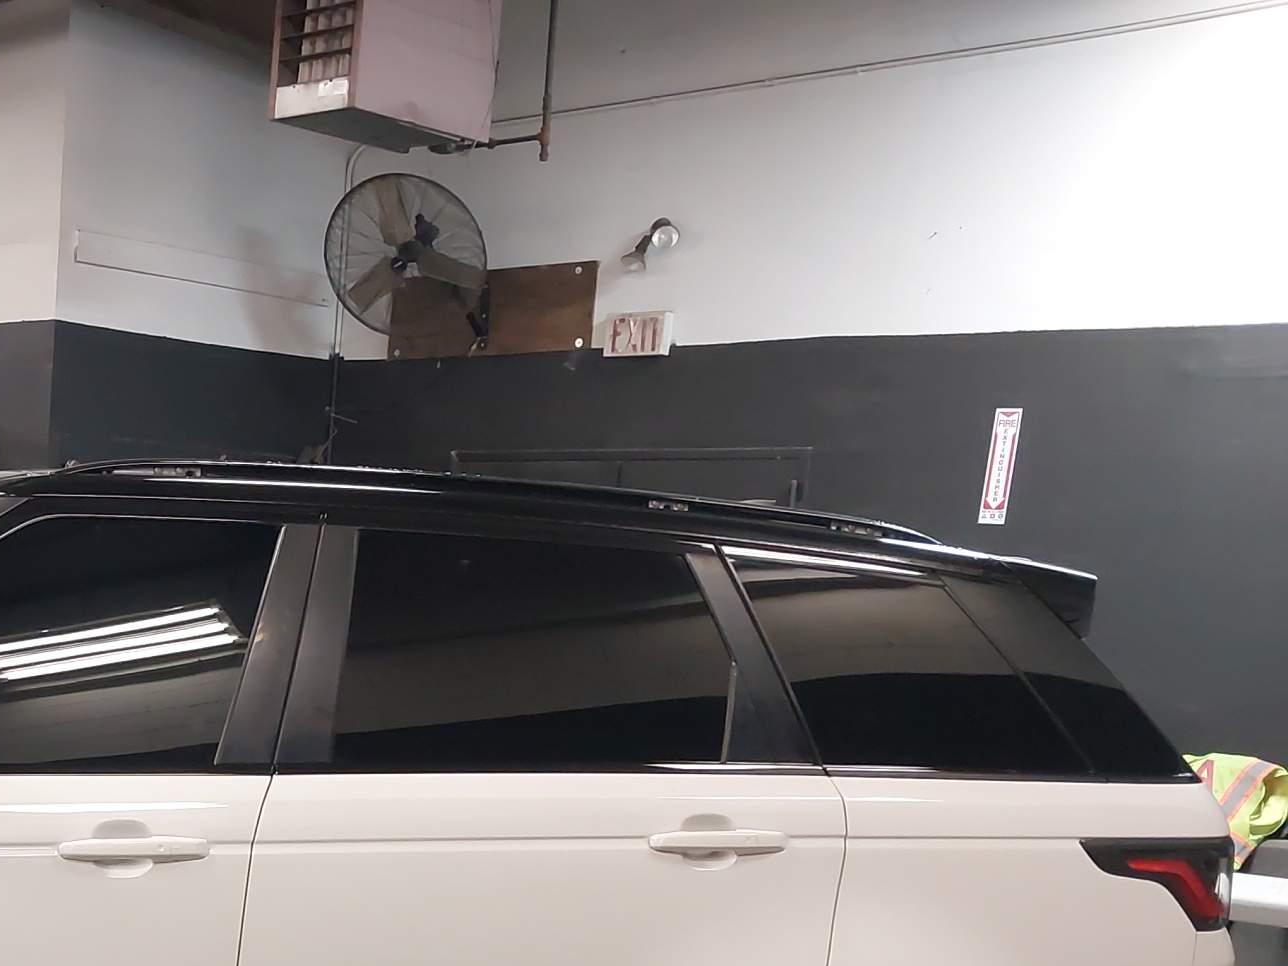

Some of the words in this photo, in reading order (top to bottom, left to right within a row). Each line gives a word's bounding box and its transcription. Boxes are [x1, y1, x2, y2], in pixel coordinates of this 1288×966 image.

[610, 316, 659, 353] EXIT
[998, 419, 1017, 428] FIRE
[992, 428, 1009, 503] EXTINGUISHER
